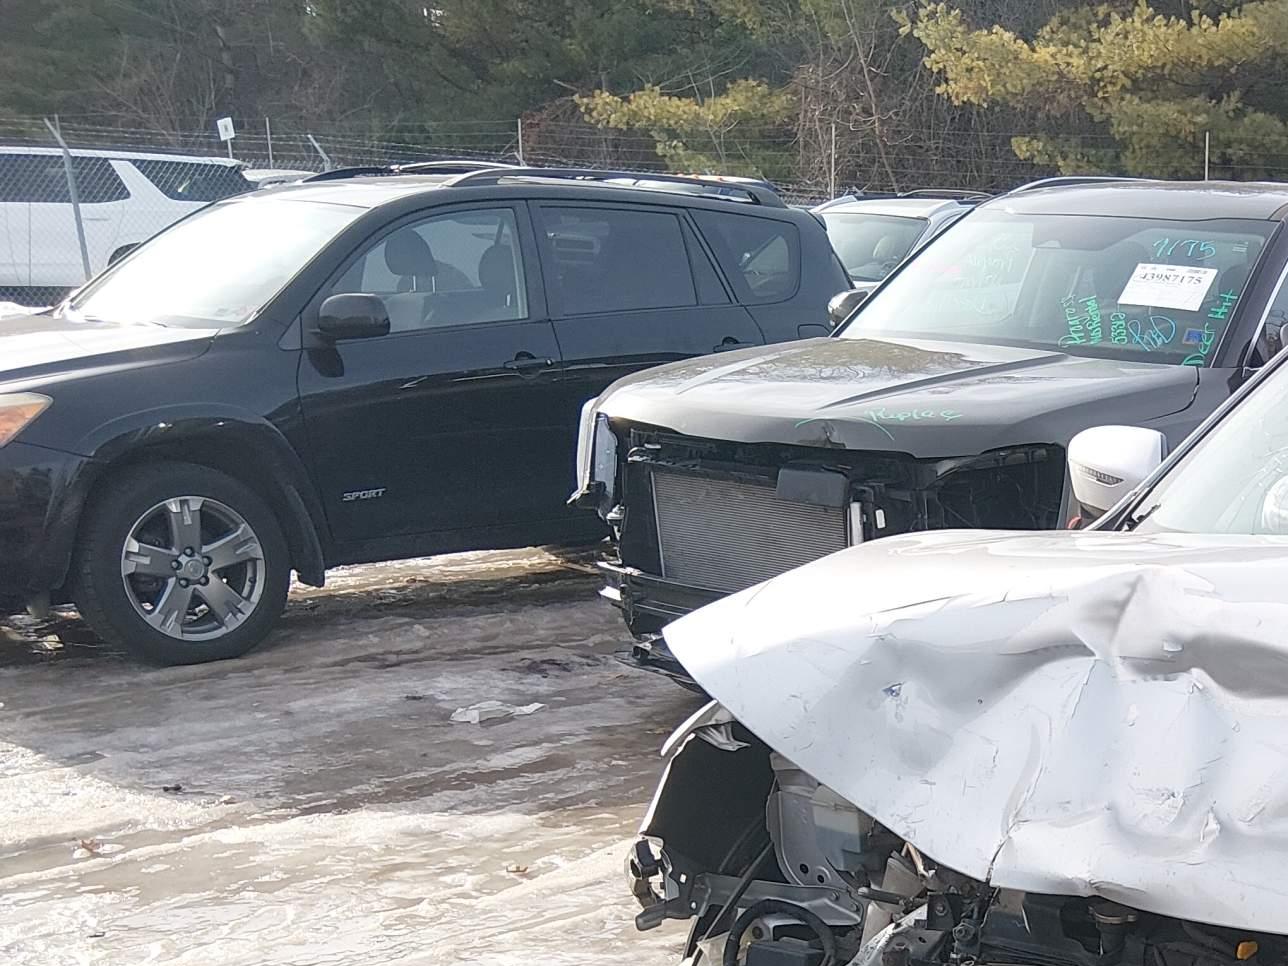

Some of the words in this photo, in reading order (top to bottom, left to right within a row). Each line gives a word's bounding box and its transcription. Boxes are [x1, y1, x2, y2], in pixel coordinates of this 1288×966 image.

[1139, 272, 1204, 285] 43987175
[1182, 323, 1215, 367] Deer
[1208, 289, 1238, 319] Hit
[343, 488, 386, 501] SPORT
